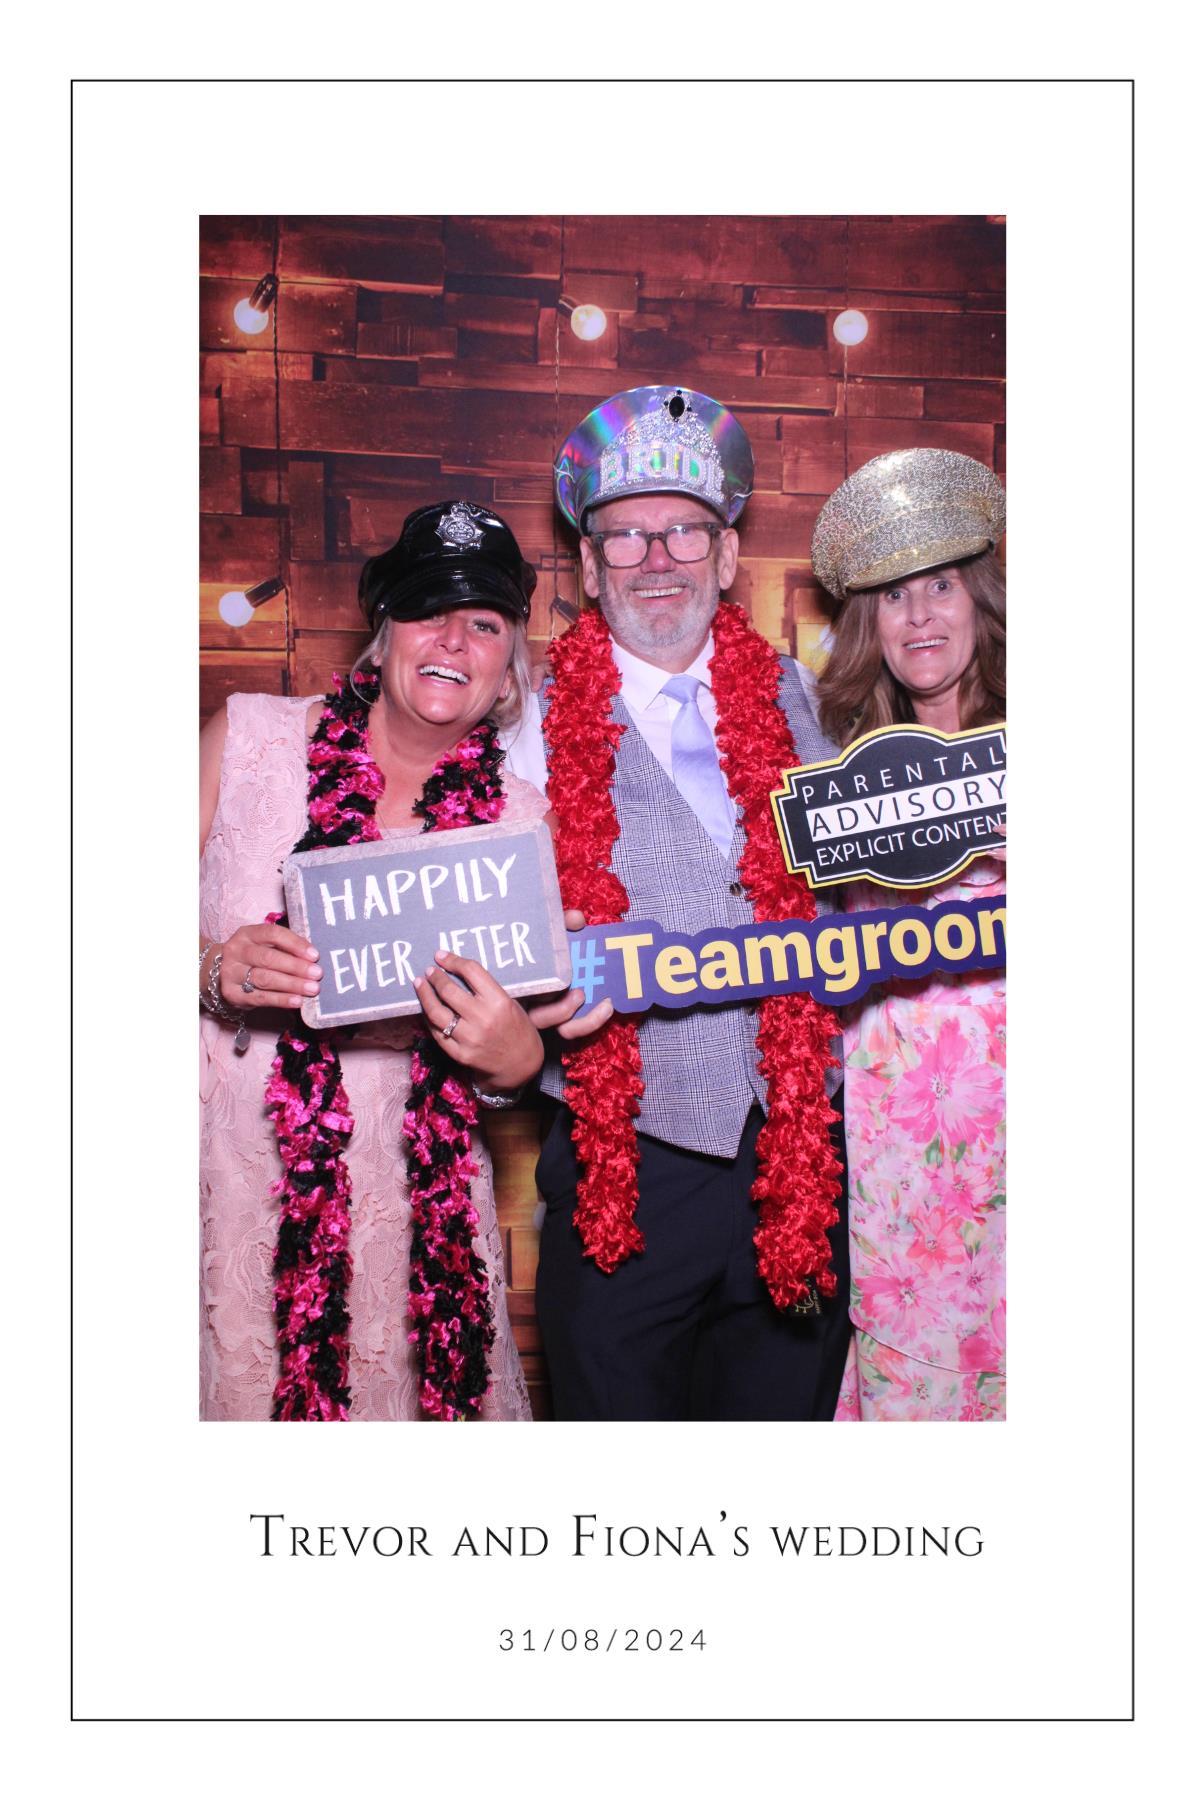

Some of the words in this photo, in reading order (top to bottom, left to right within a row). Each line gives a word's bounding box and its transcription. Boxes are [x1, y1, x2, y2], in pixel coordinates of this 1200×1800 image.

[802, 746, 1003, 804] PARENTAL
[812, 774, 1006, 838] ADVISORY
[816, 832, 905, 867] EXPLICIT
[911, 811, 1006, 847] CONTEN
[319, 853, 517, 926] HAPPILY
[330, 940, 416, 994] EVER
